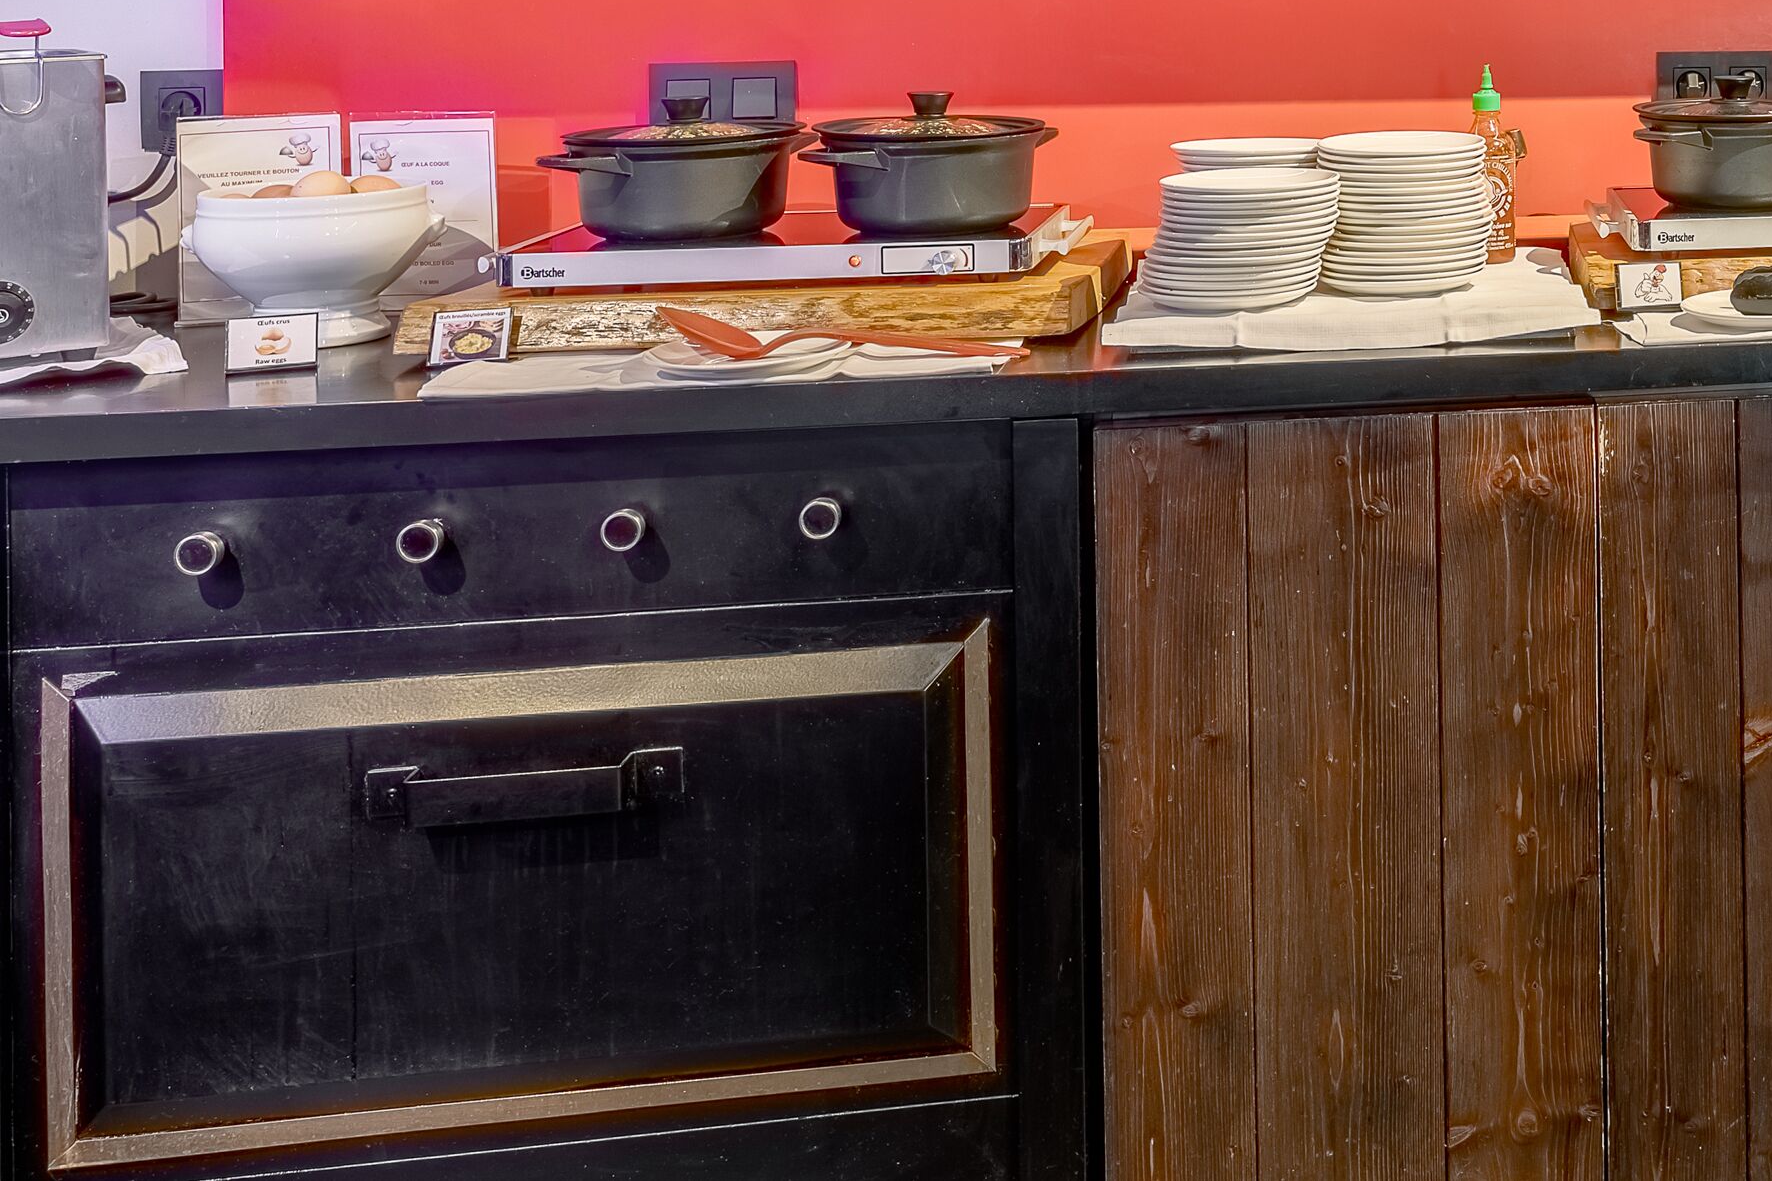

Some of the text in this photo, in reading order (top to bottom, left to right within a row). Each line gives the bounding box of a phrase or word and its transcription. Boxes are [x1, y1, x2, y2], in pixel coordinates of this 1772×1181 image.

[197, 167, 300, 180] VEUILLEZ TOURNER LE BOUTON
[220, 179, 263, 189] AU MAXIMUM
[1656, 230, 1695, 245] Bartscher
[521, 266, 566, 280] Bartscher
[257, 318, 273, 326] Œufs
[270, 357, 287, 366] eggs
